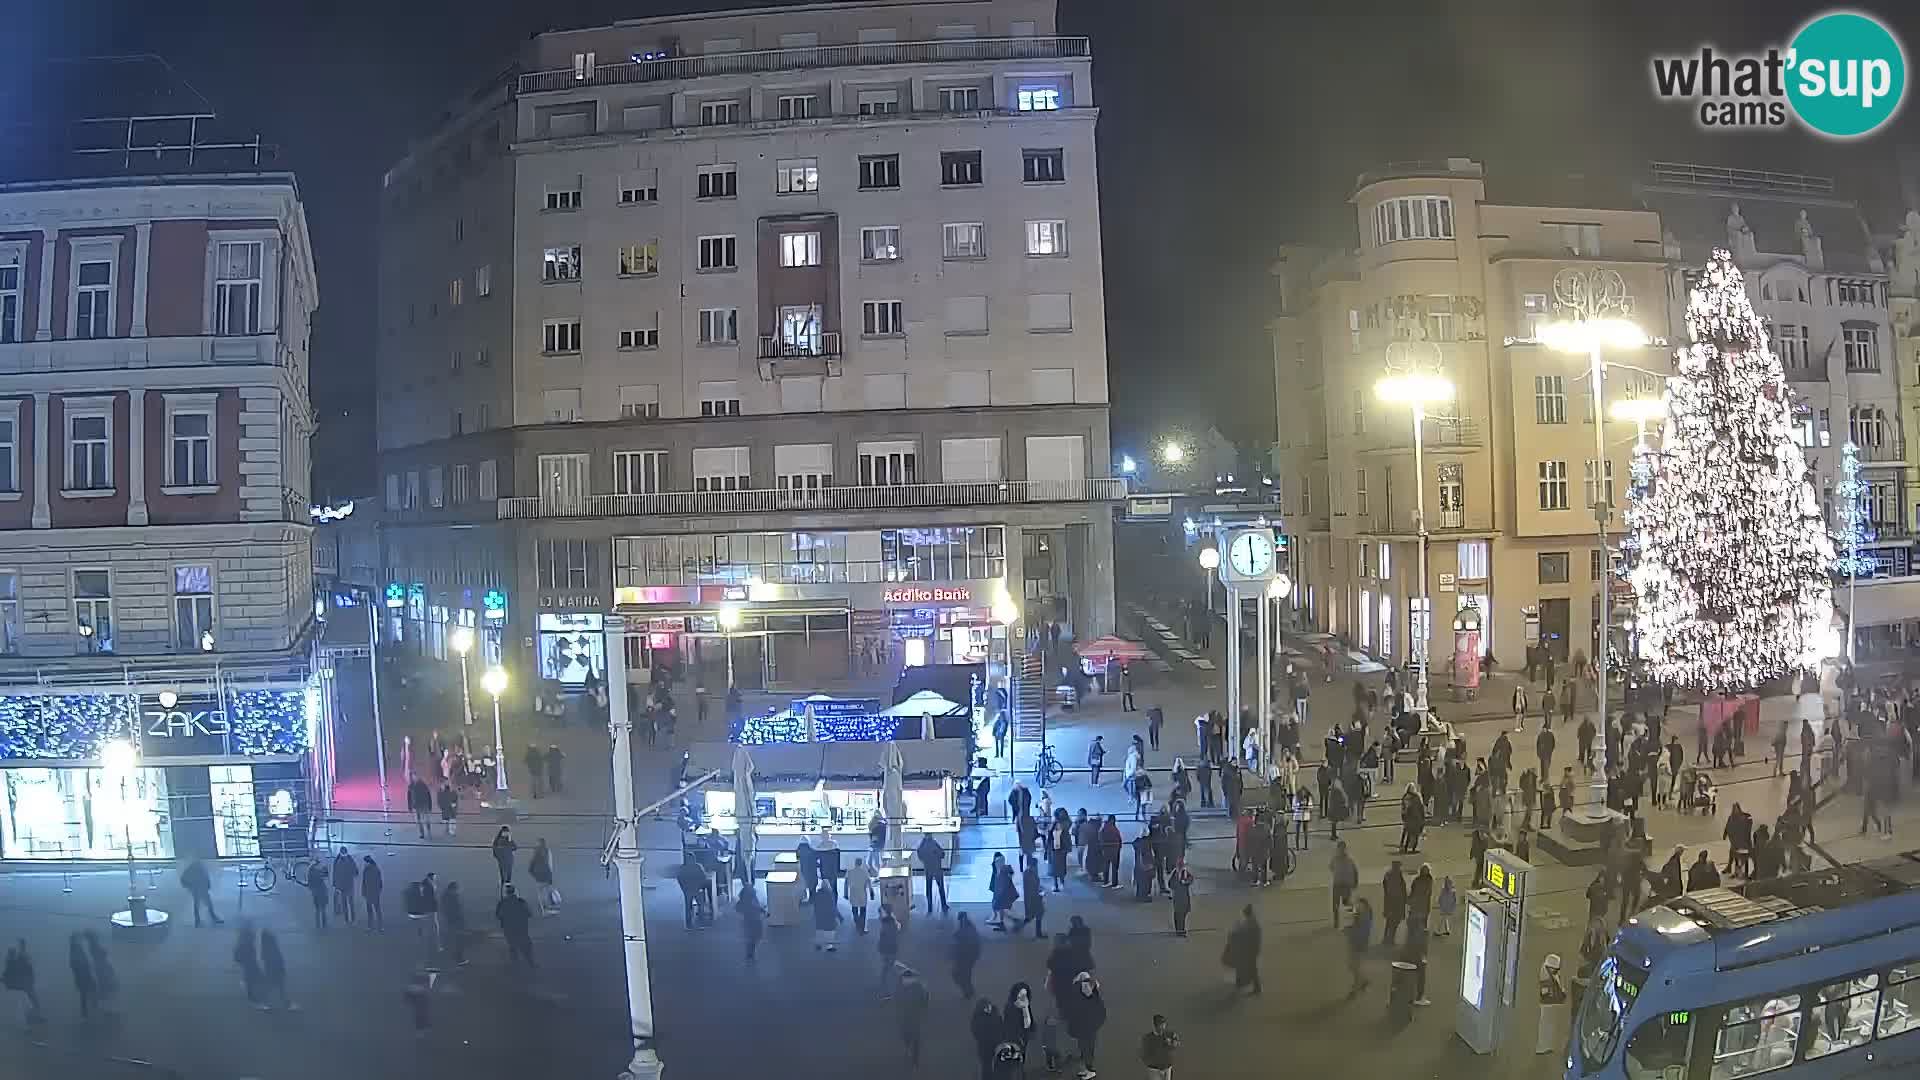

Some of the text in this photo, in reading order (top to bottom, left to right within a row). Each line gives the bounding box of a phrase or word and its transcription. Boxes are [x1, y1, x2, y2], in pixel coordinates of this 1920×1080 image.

[884, 587, 970, 602] Addiko Bank
[144, 711, 230, 737] ZAKS
